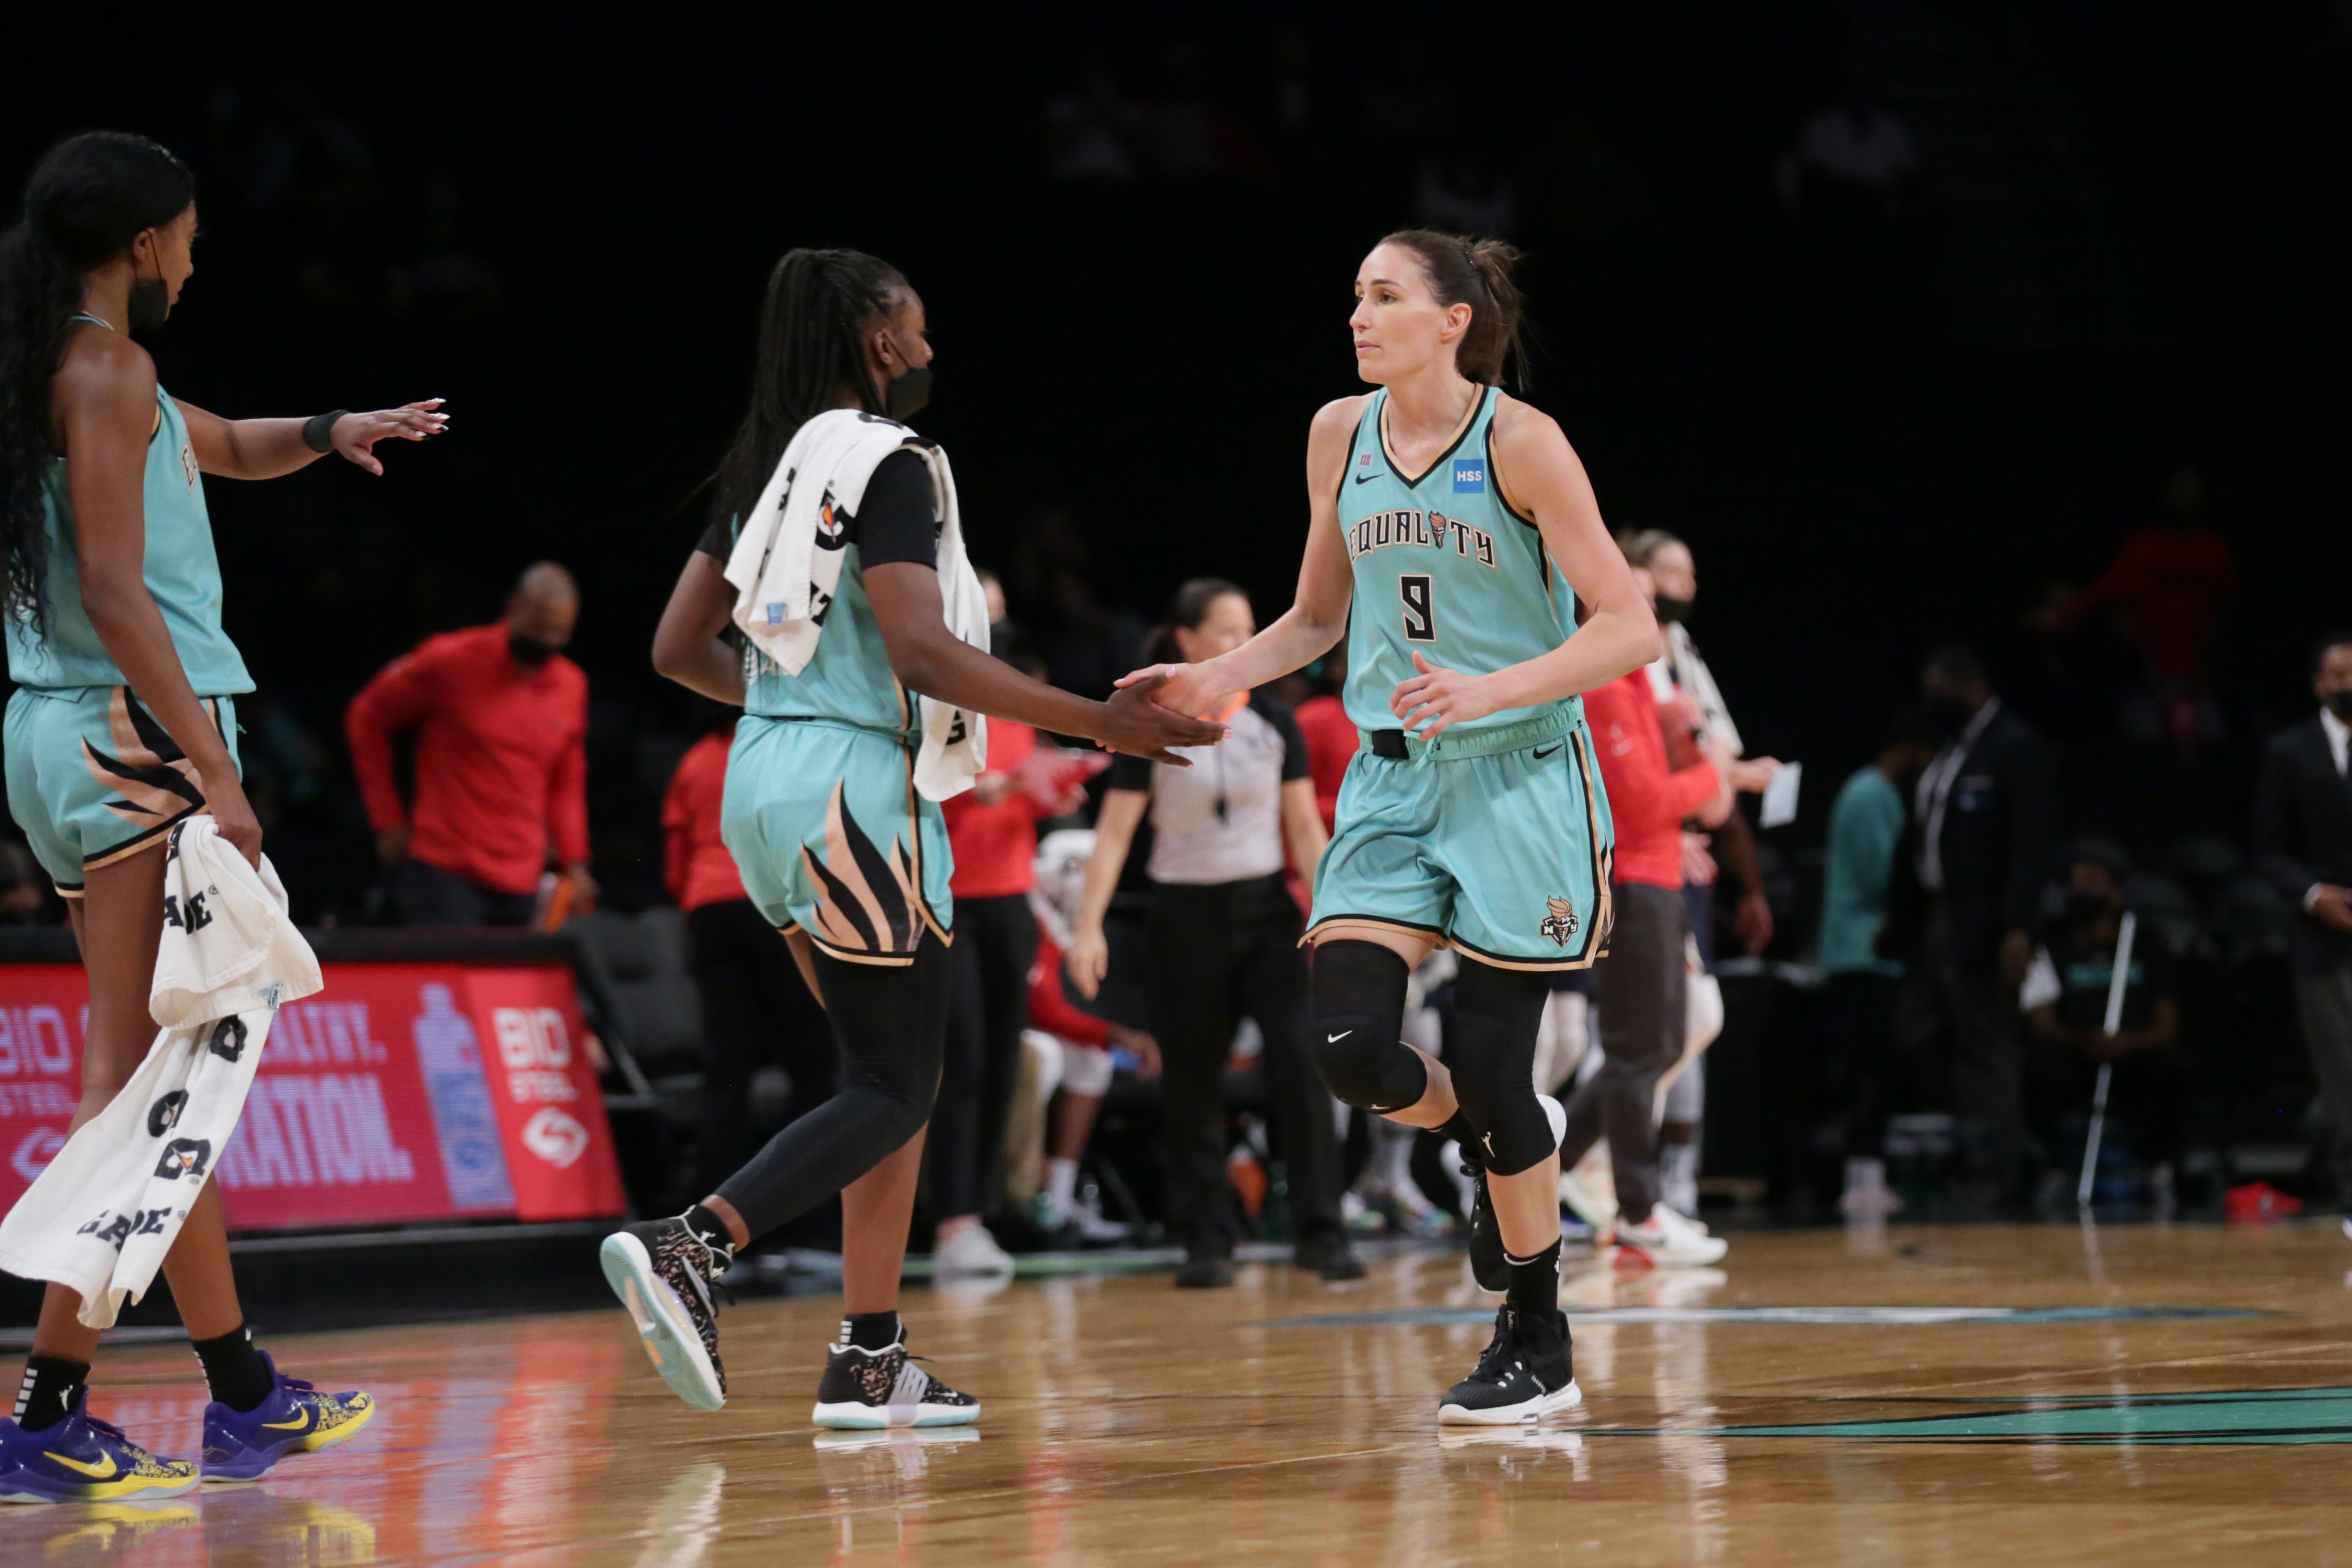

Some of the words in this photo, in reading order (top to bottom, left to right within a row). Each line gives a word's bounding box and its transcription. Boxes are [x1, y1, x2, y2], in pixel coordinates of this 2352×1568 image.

[1457, 470, 1483, 482] HSS
[1398, 573, 1437, 643] 9
[492, 1006, 573, 1070] BIO
